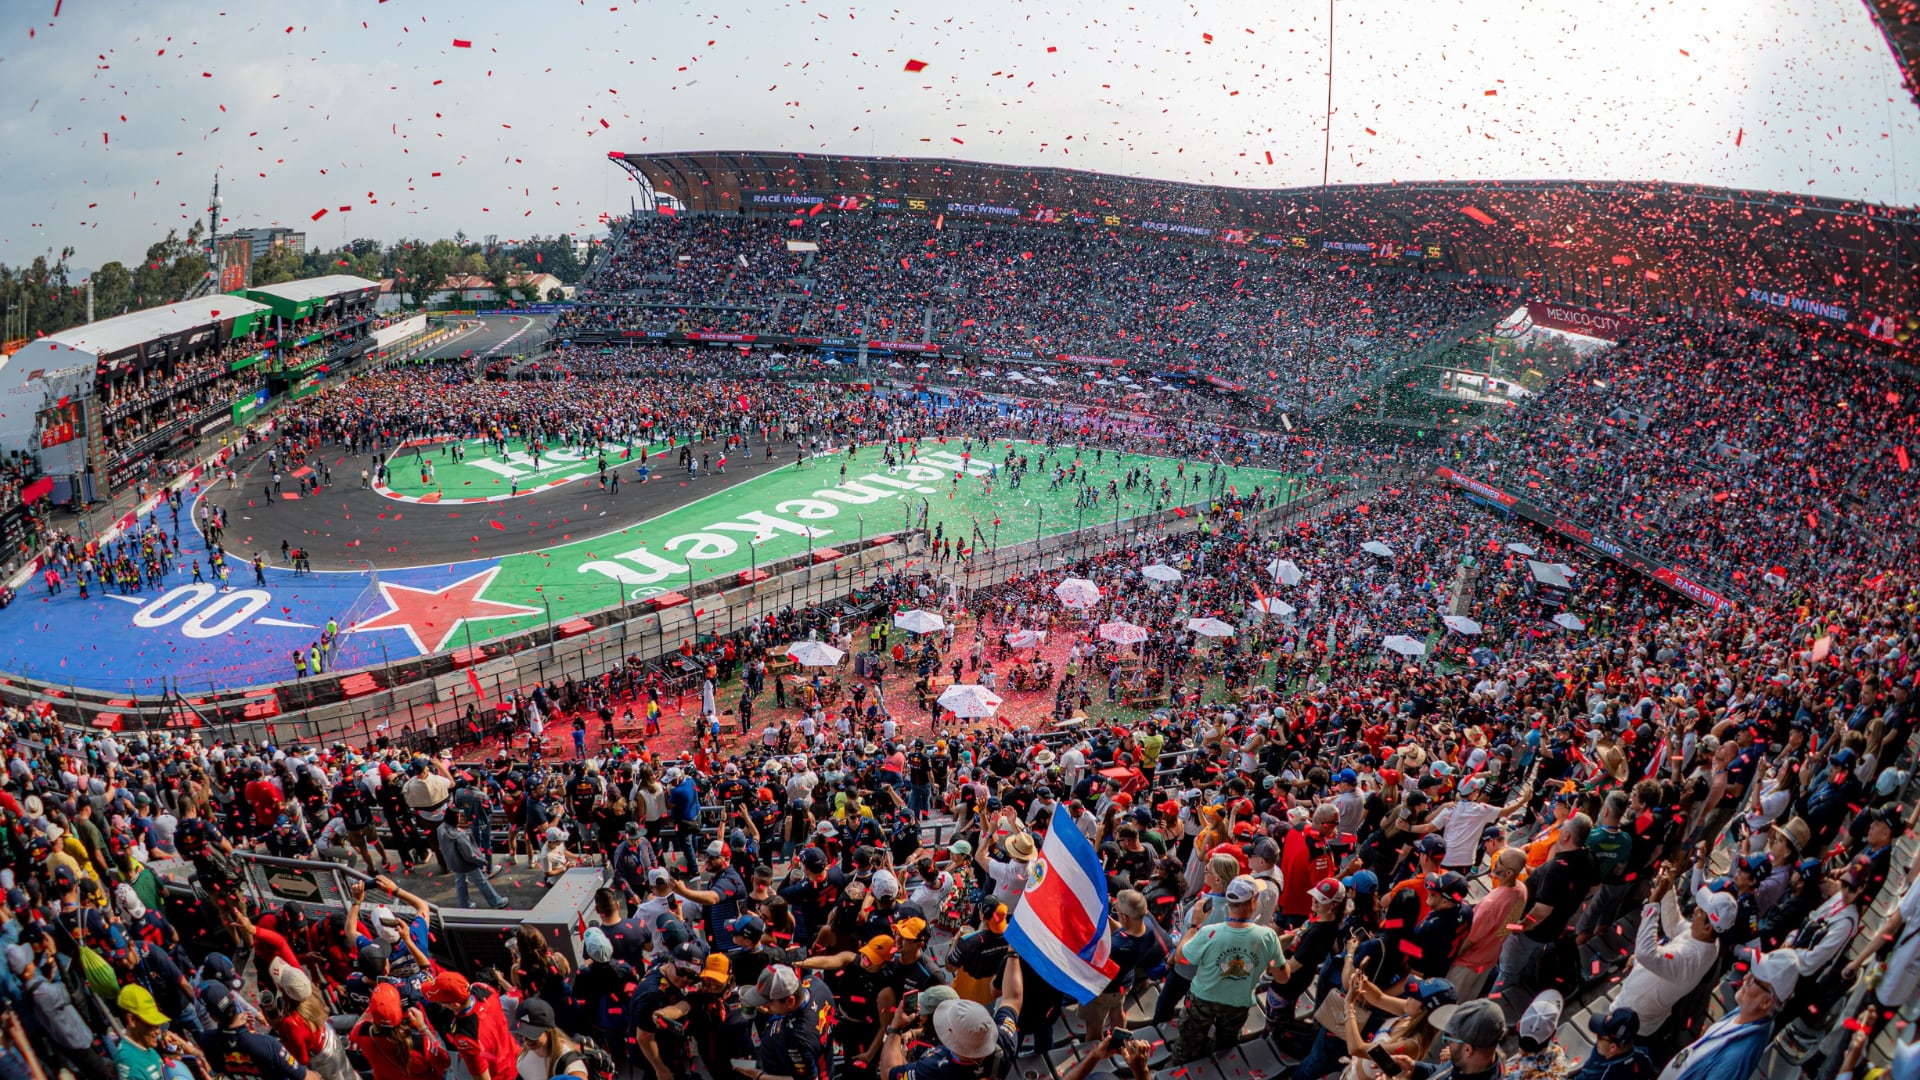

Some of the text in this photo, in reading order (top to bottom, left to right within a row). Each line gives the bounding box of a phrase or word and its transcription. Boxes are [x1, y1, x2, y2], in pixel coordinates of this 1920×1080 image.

[753, 194, 824, 204] RACE WINNER
[909, 200, 925, 210] 55
[948, 203, 1020, 216] RACE WINNER
[1104, 216, 1121, 226] 55
[1142, 220, 1211, 235] RACE WINNER
[1323, 241, 1344, 250] RACE
[1428, 247, 1441, 258] 55
[1750, 288, 1848, 322] RACE WINNER
[1546, 307, 1590, 325] MEXICO
[1593, 316, 1620, 331] CITY
[1451, 473, 1499, 499] RACE WINNER
[1554, 519, 1623, 555] CARLOS SAINZ
[1675, 578, 1701, 597] RACE
